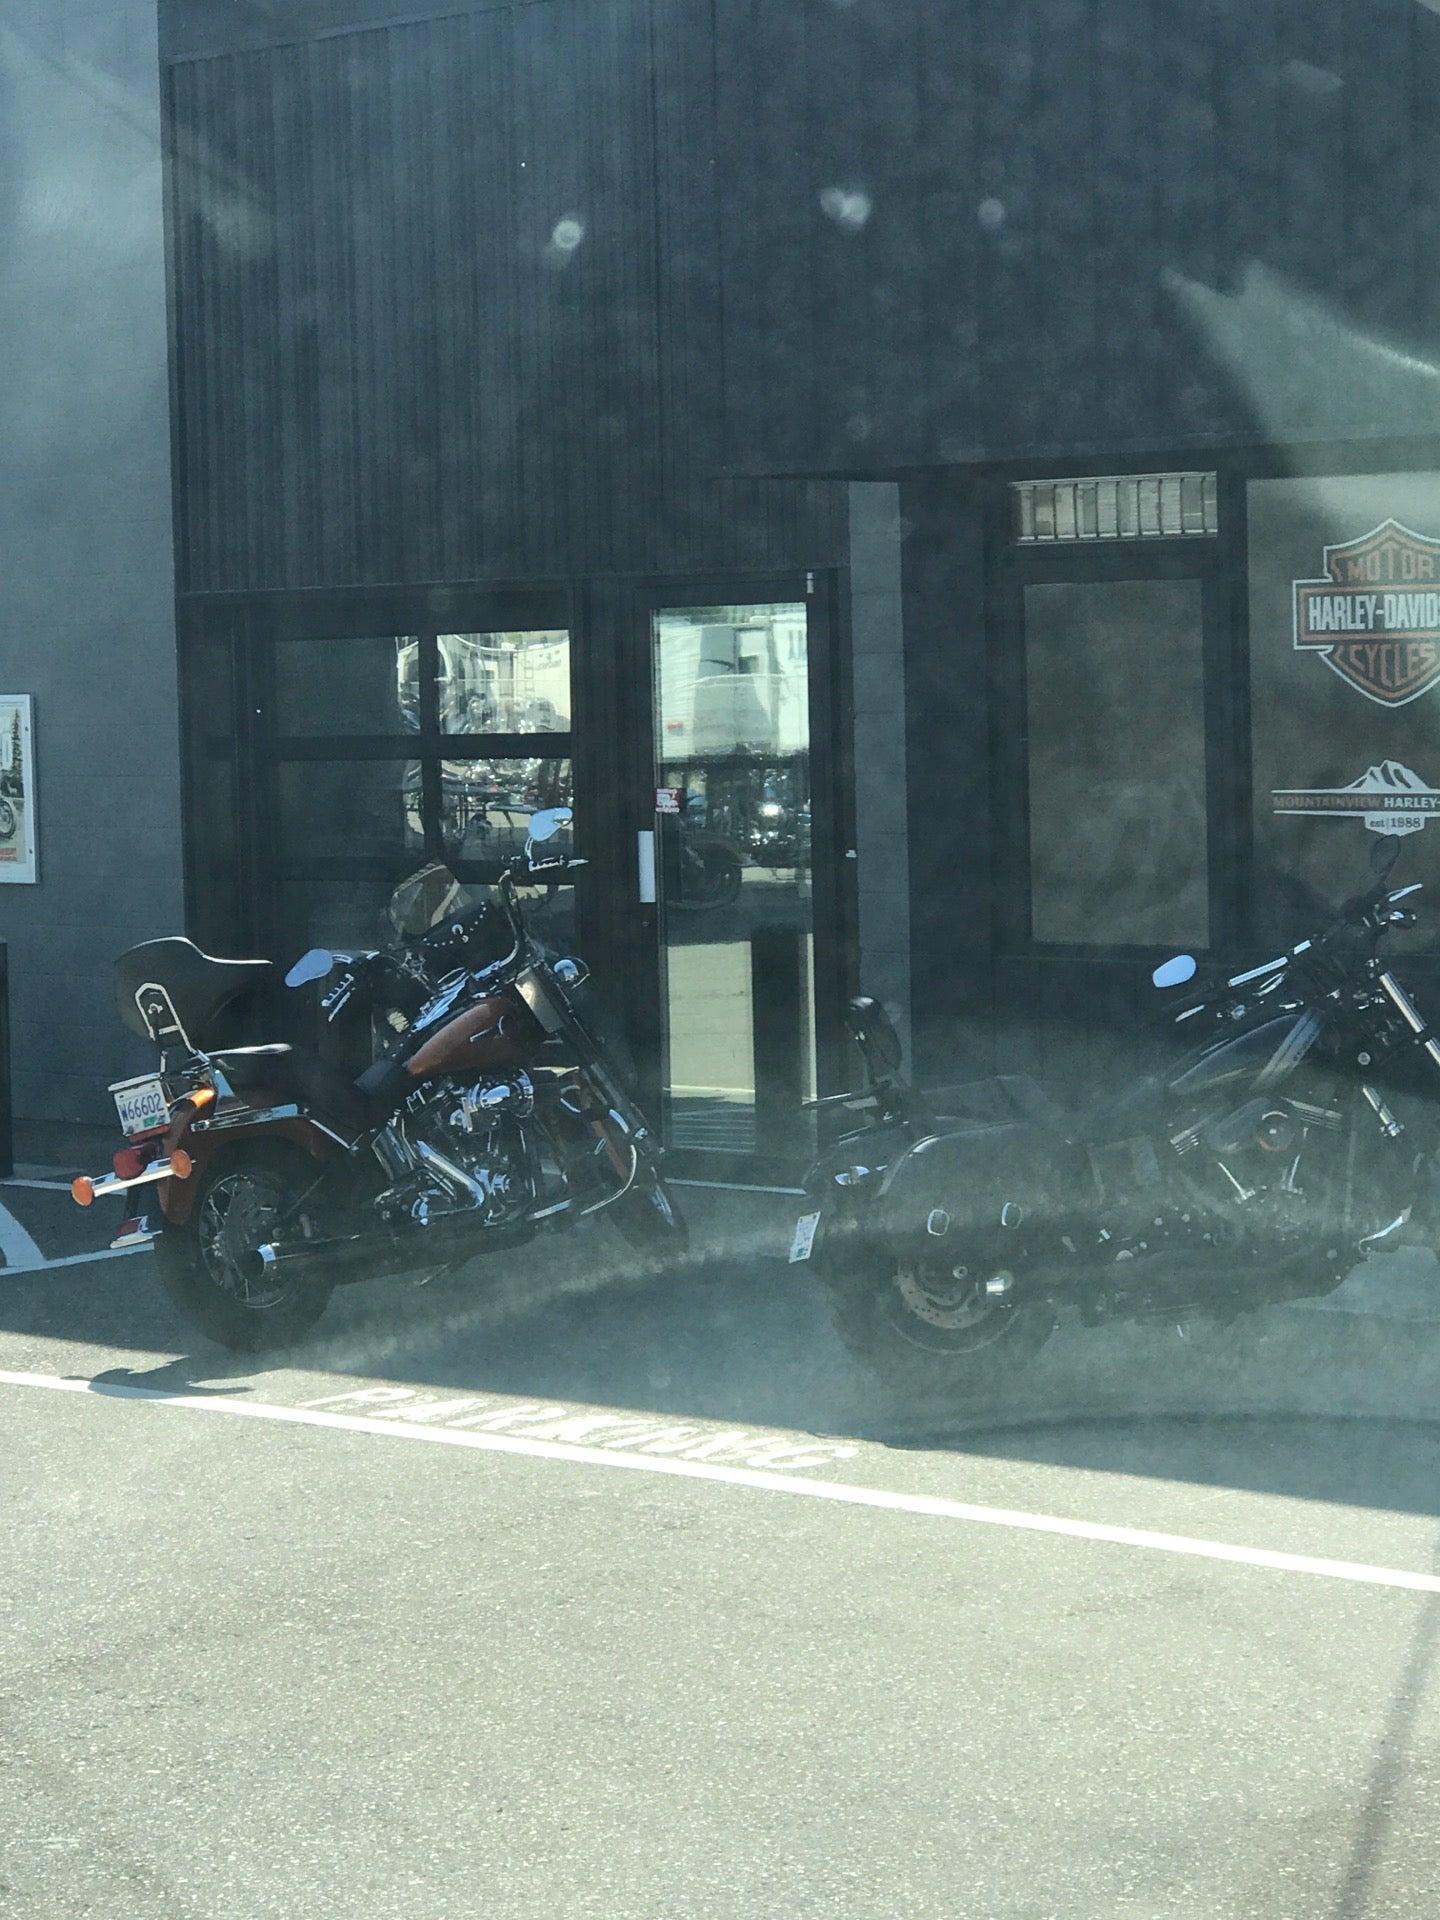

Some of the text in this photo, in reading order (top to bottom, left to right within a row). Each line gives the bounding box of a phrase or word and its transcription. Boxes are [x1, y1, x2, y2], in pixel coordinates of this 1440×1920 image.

[1348, 542, 1434, 581] MOTOR
[1308, 593, 1440, 631] HARLEY-DAVID
[1349, 643, 1437, 686] CYCLES
